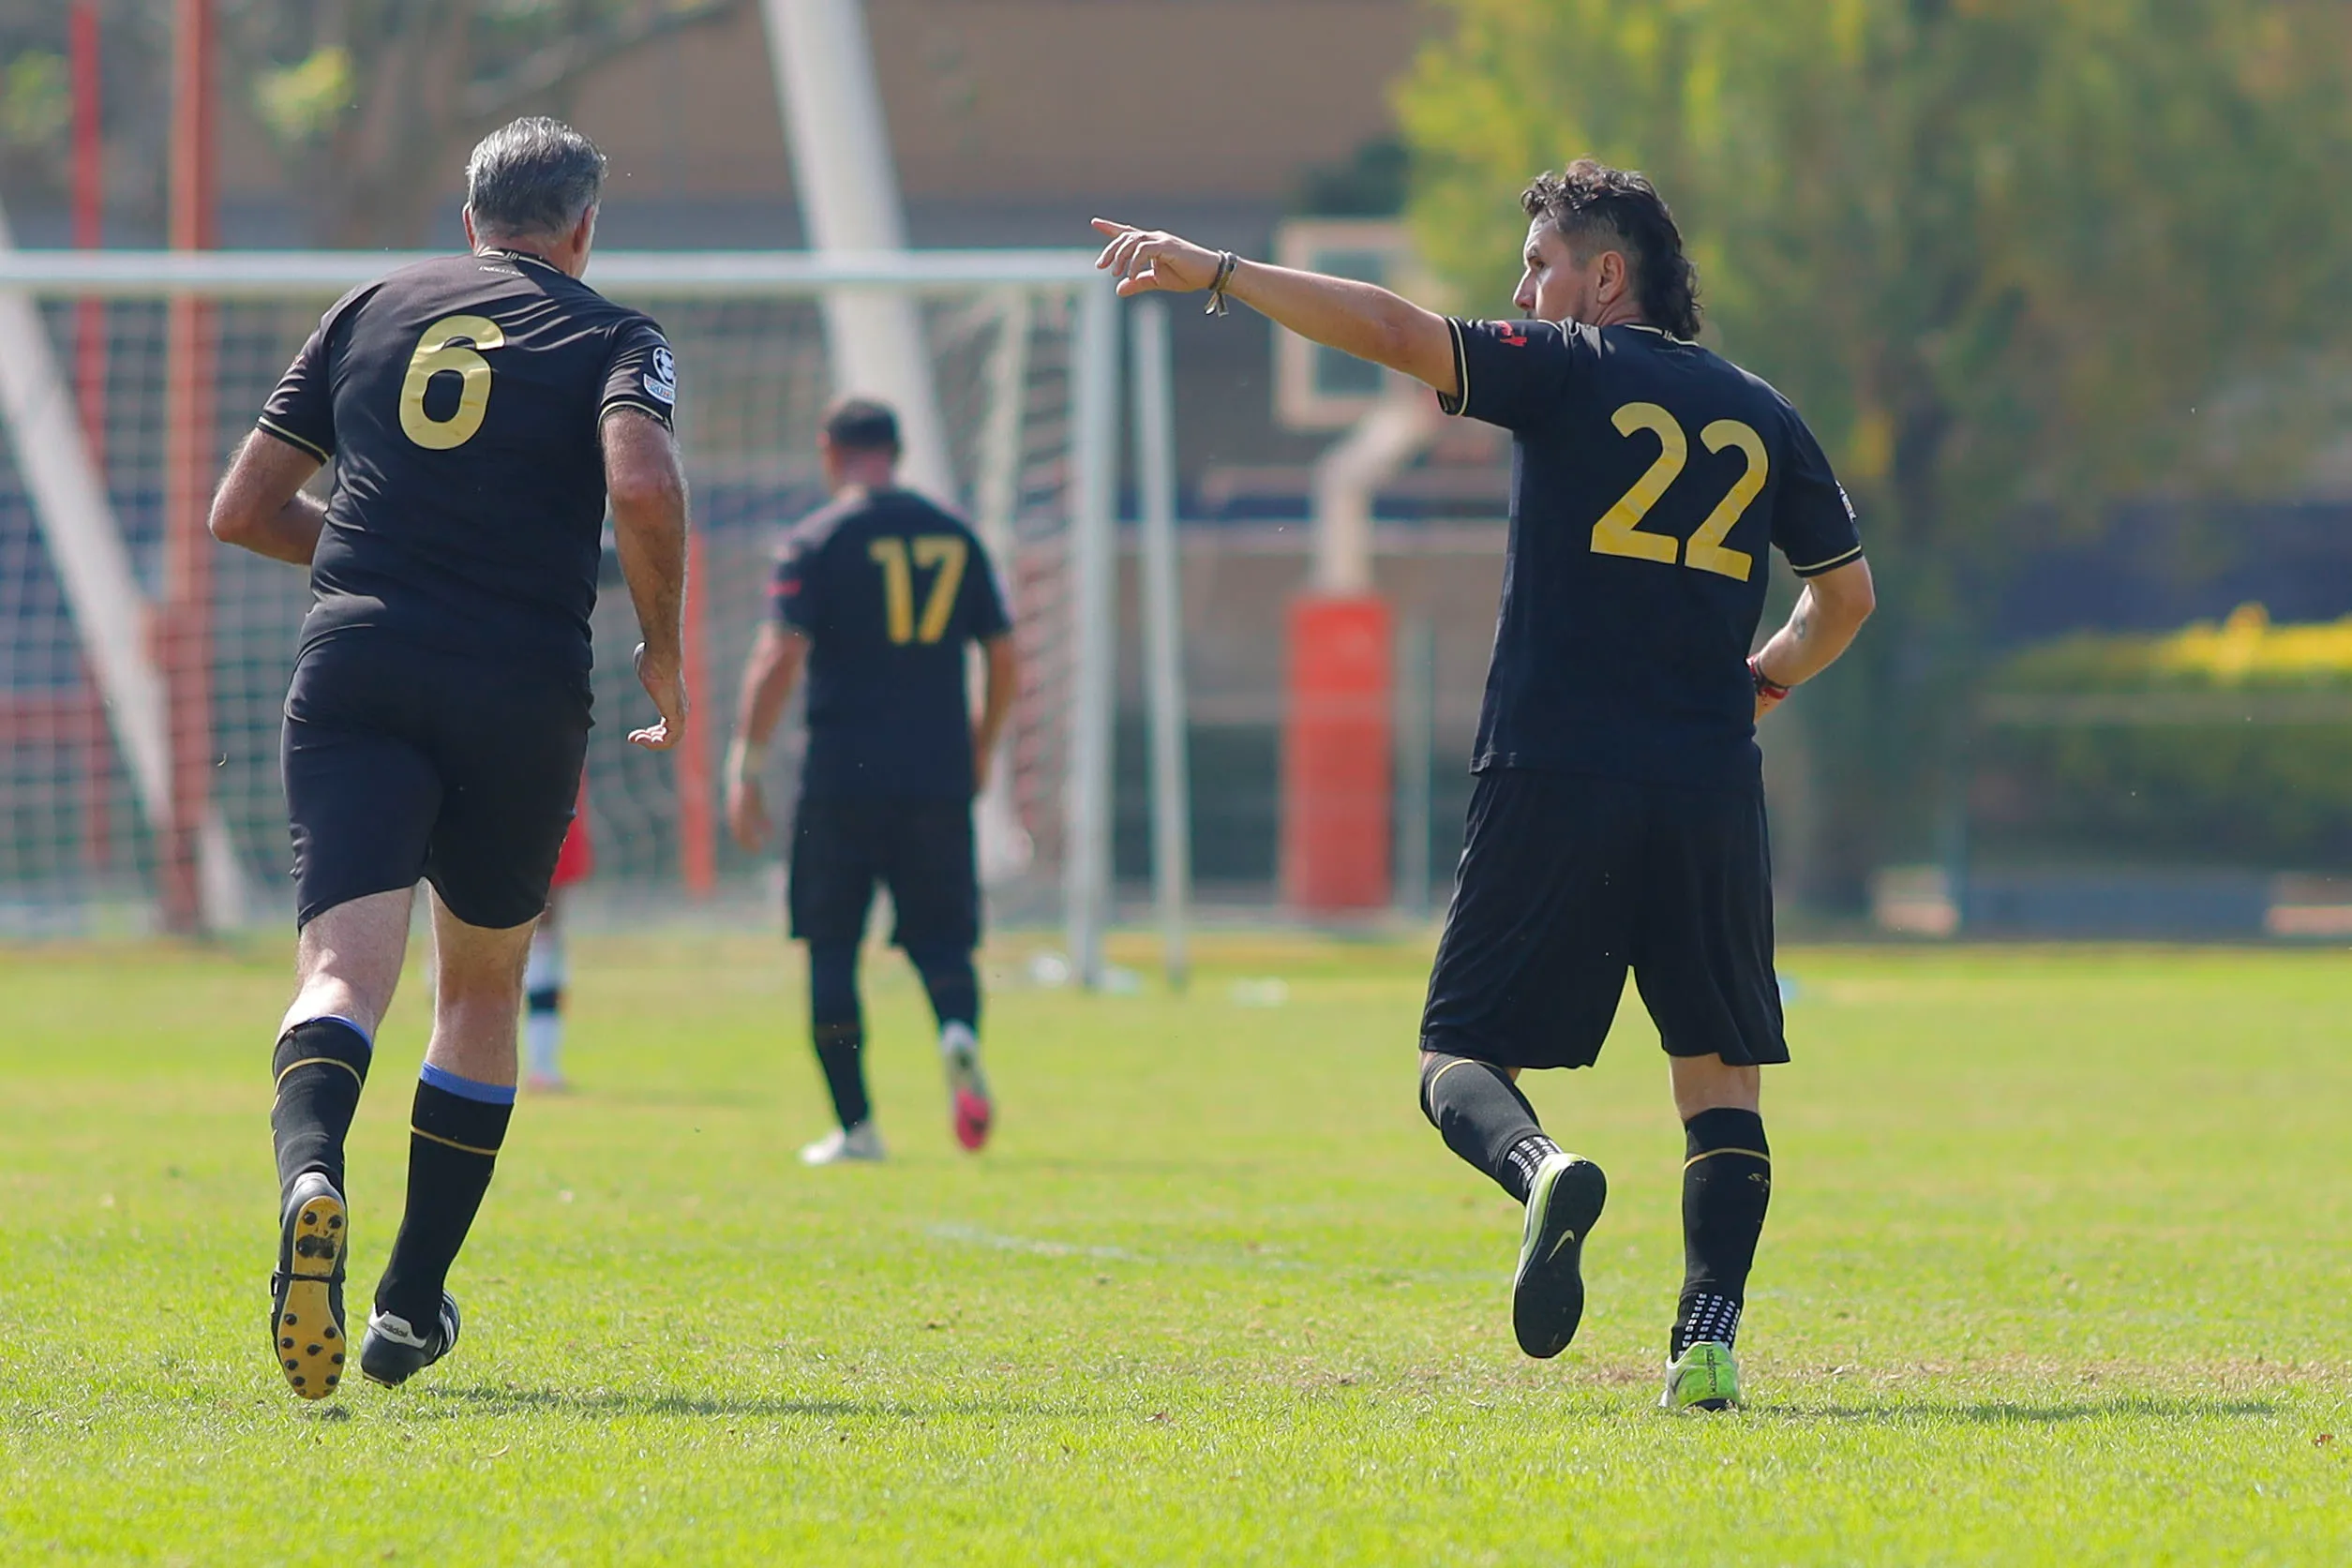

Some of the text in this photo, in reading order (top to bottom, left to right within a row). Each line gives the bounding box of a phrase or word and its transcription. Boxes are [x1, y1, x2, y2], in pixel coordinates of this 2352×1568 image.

[399, 314, 505, 450] 6
[1591, 402, 1769, 582] 22
[870, 535, 967, 644] 17
